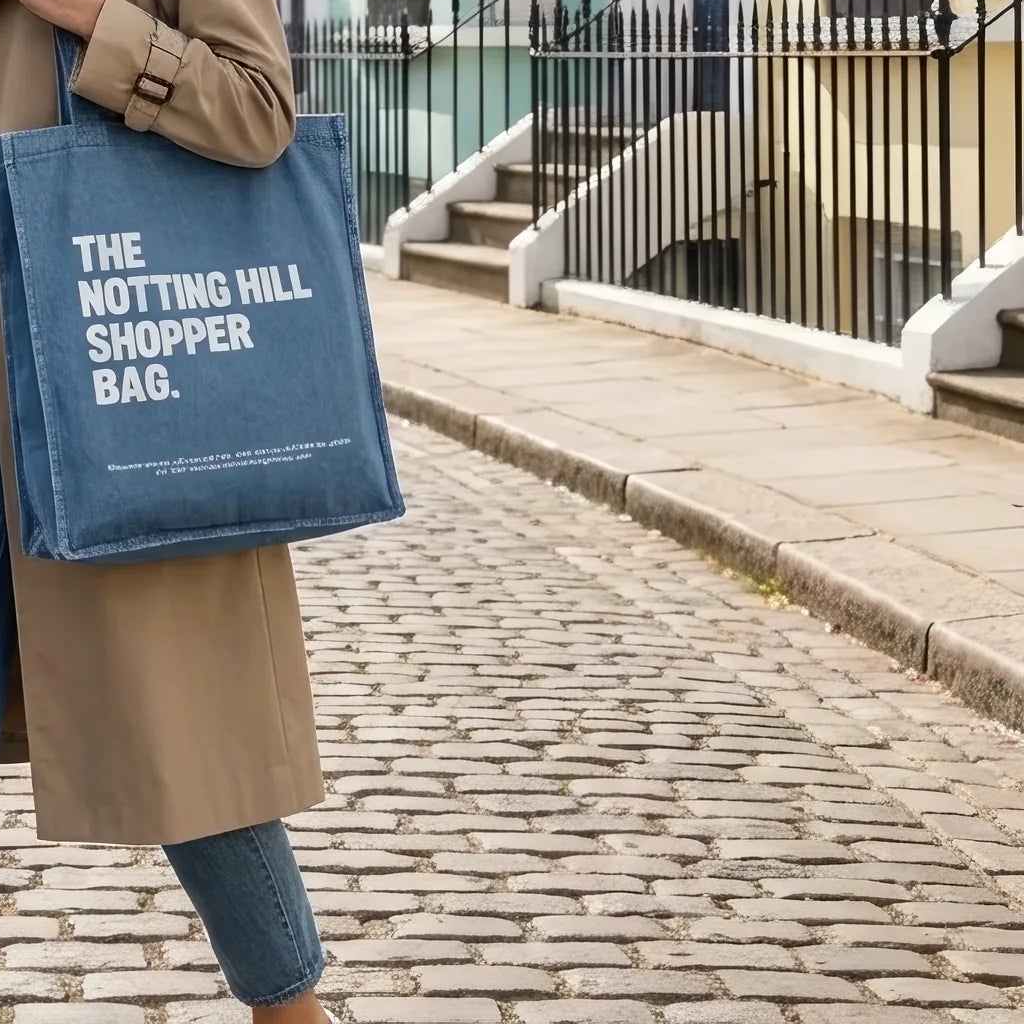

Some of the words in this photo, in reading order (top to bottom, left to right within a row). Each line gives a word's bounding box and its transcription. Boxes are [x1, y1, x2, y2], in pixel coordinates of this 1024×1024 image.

[71, 232, 146, 273] THE
[77, 271, 232, 318] NOTTING
[235, 263, 313, 305] HILL
[85, 313, 255, 363] SHOPPER
[92, 363, 181, 406] BAG.
